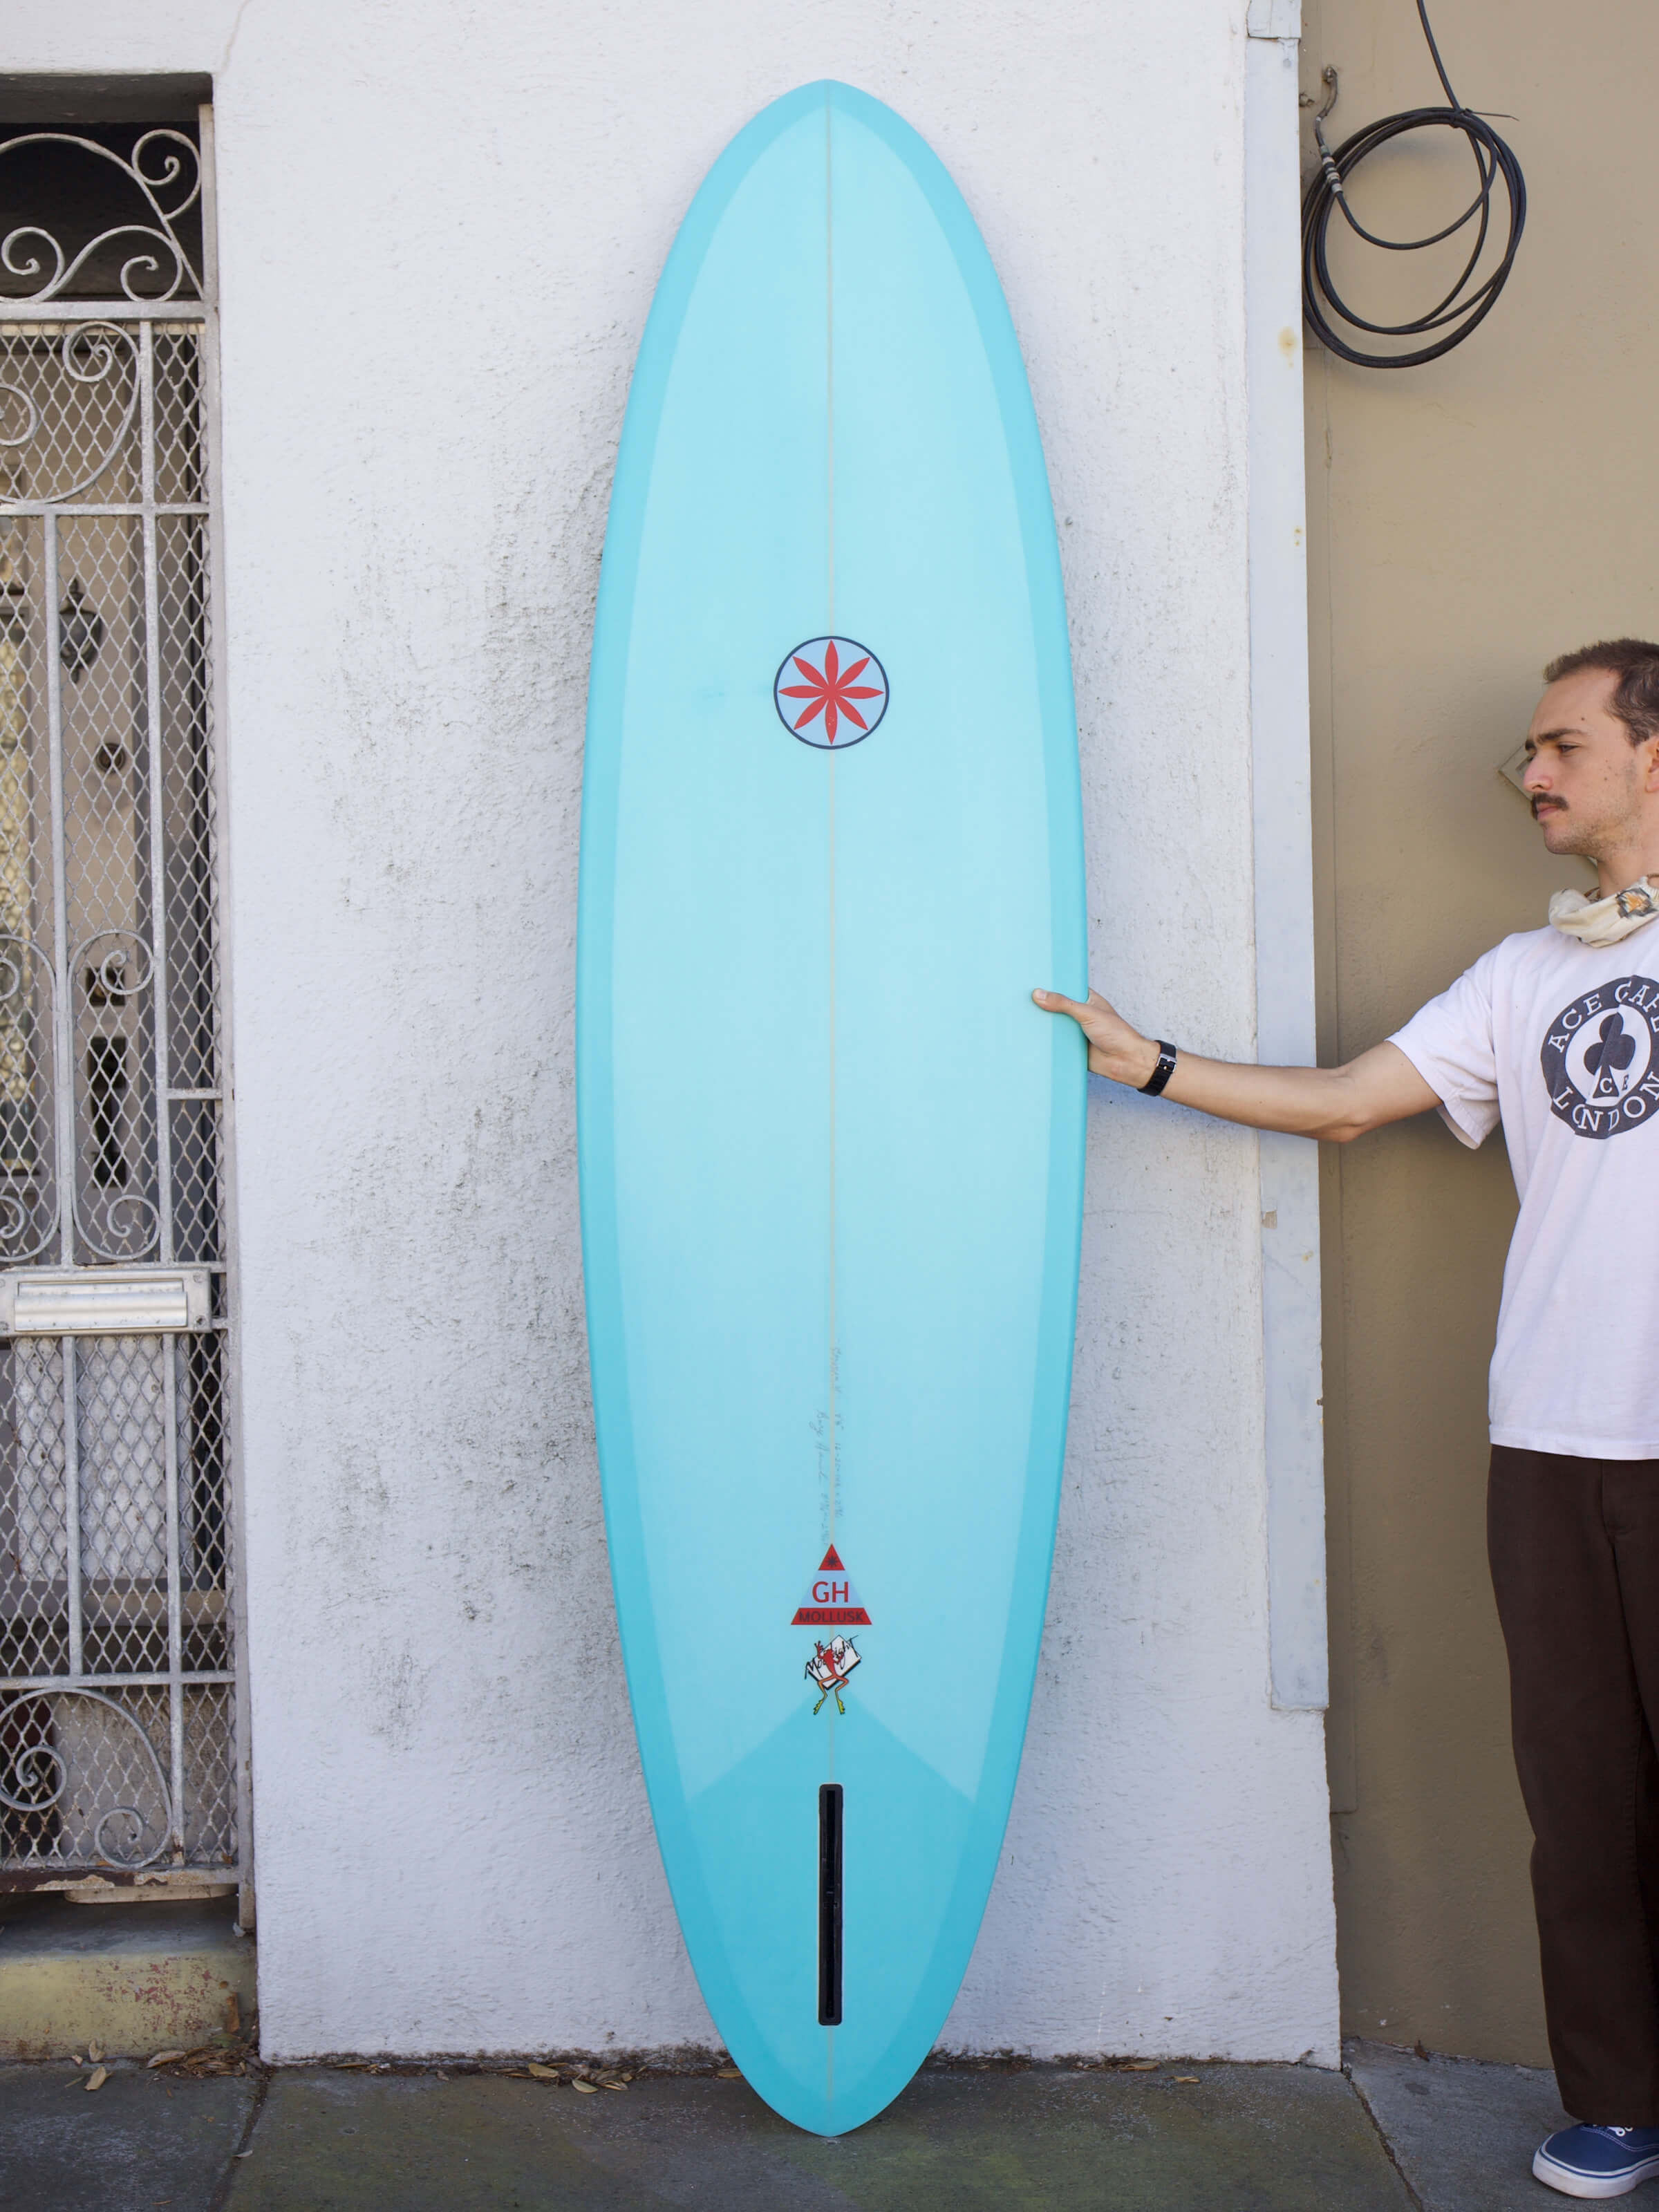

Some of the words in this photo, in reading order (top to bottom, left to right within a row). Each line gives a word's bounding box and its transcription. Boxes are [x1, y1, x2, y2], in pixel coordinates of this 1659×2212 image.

[1548, 993, 1602, 1053] ACE
[812, 1581, 849, 1603] GH
[798, 1610, 863, 1622] MOLLUSK
